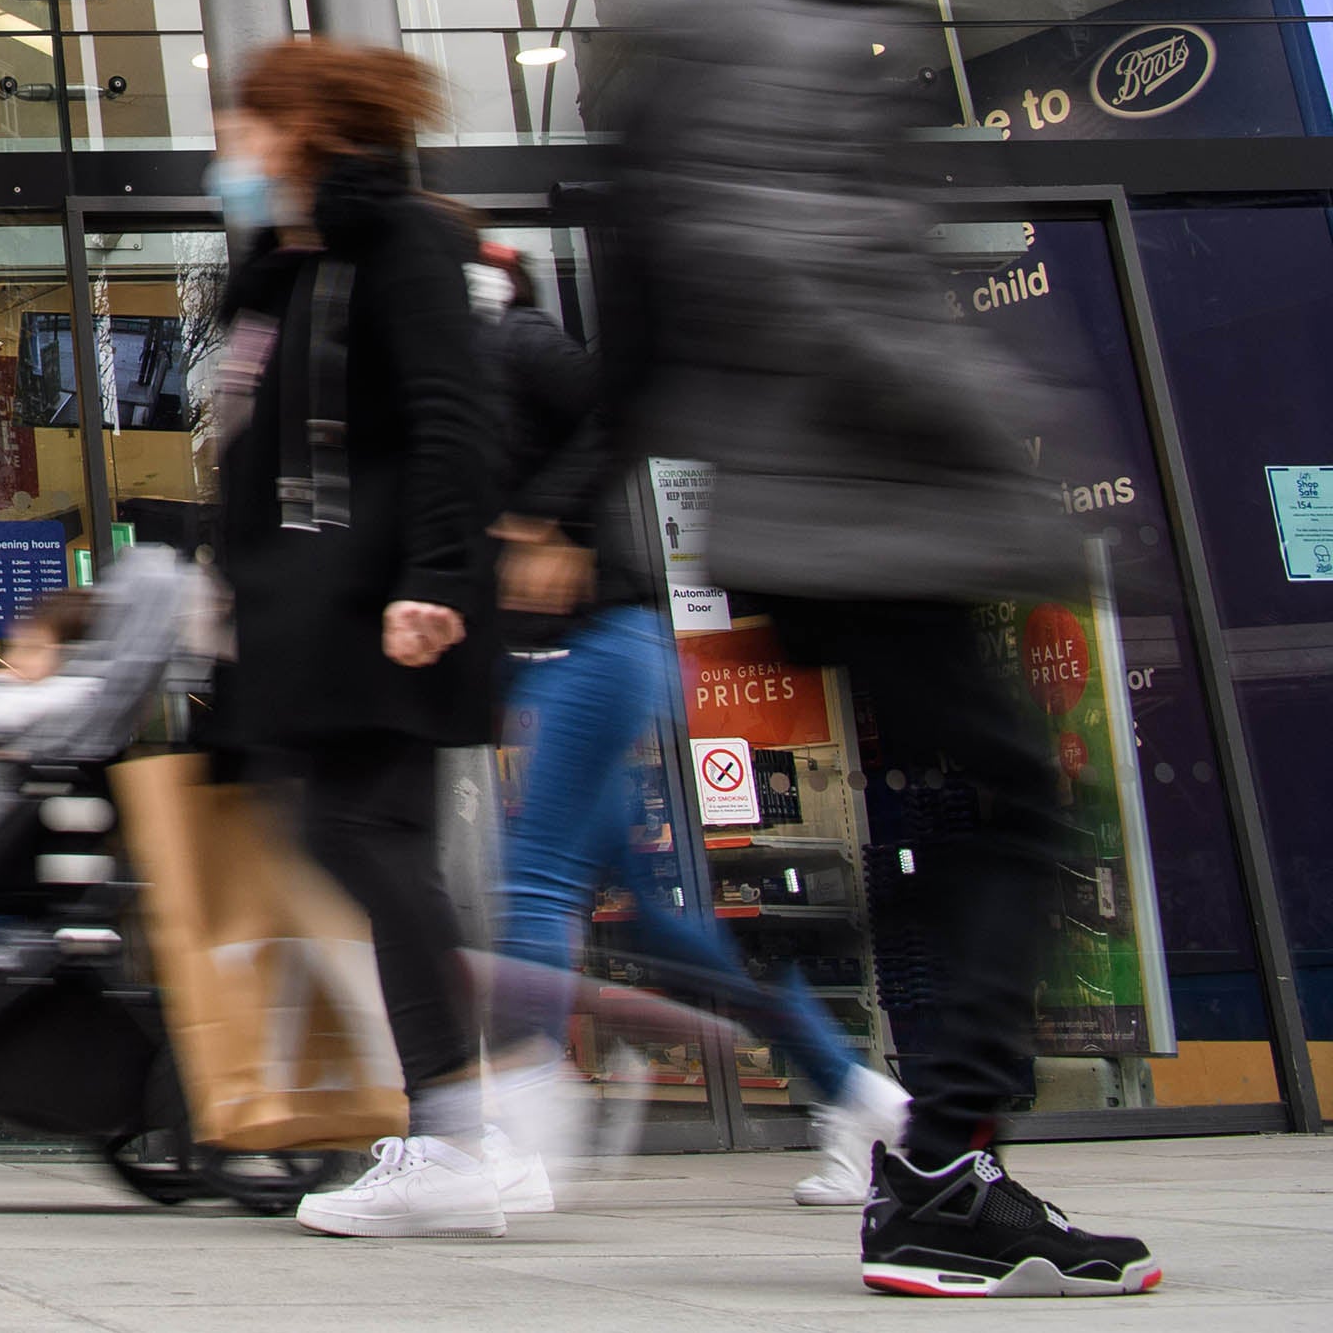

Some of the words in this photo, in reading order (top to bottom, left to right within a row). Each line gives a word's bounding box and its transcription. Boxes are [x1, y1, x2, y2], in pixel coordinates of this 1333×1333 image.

[1113, 34, 1190, 106] Boots
[1023, 88, 1071, 130] to
[973, 262, 1049, 311] child
[658, 470, 717, 478] CORONAV
[1297, 480, 1318, 488] Shop
[1297, 501, 1312, 509] 154
[32, 540, 60, 548] hours
[673, 588, 723, 598] Automatic
[688, 604, 712, 612] Door
[1031, 640, 1073, 664] HALF
[701, 668, 731, 683] OUR
[737, 662, 782, 678] GREAT
[1032, 660, 1081, 686] PRICE
[696, 677, 794, 709] PRICES
